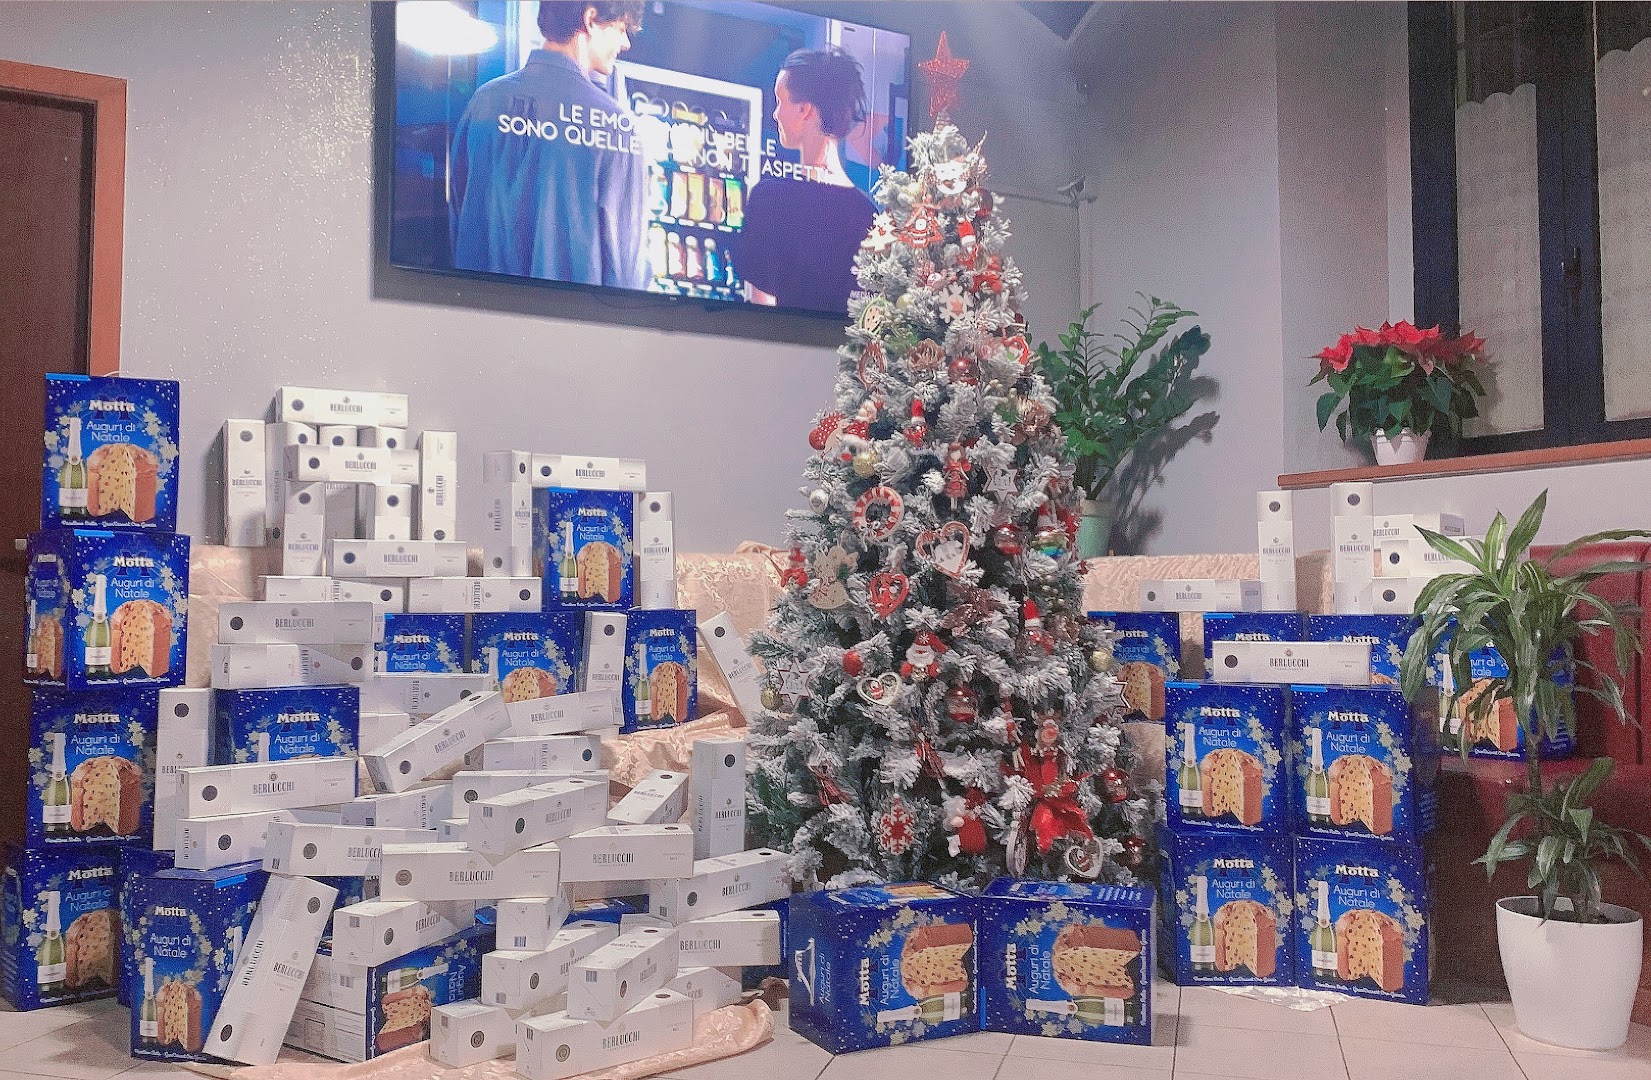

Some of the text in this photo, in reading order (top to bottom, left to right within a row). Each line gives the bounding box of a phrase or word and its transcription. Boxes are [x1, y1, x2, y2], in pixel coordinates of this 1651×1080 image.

[498, 114, 559, 141] SONO
[564, 125, 641, 155] QUELLE
[559, 103, 583, 125] LE
[725, 131, 777, 158] BEE
[89, 400, 136, 412] Motta
[330, 403, 363, 413] BERLUCCHI
[86, 421, 136, 434] Auguri di
[91, 432, 131, 442] Natale
[345, 460, 376, 470] BERLUCCHI
[578, 508, 608, 518] Motta
[576, 524, 609, 534] Auguri di
[579, 533, 605, 541] Natale
[113, 556, 154, 568] Motta
[384, 554, 418, 563] BERLUCCHI
[111, 577, 155, 591] Auguri di
[115, 588, 150, 600] Natale
[275, 619, 315, 629] BERLUCCHI
[503, 632, 539, 641] Motta
[650, 628, 675, 637] Motta
[1235, 633, 1270, 641] Motta
[393, 634, 431, 644] Motta
[1342, 635, 1381, 644] Motta
[391, 651, 431, 662] Auguri di
[502, 649, 540, 660] Auguri di
[395, 661, 427, 670] Natale
[505, 658, 535, 667] Natale
[1270, 657, 1309, 668] BERLUCCHI
[1471, 667, 1492, 677] tale
[73, 713, 120, 724] Motta
[277, 712, 320, 724] Motta
[530, 709, 564, 723] BERLUCCHI
[1200, 707, 1241, 718] Motta
[1328, 711, 1369, 723] Motta
[275, 733, 320, 745] Auguri di
[1199, 727, 1242, 739] Auguri di
[1326, 732, 1370, 743] Auguri di
[71, 735, 121, 746] Auguri di
[434, 730, 467, 754] BERLUCCHI
[1203, 737, 1237, 748] Natale
[76, 745, 115, 755] Natale
[280, 744, 316, 755] Natale
[1330, 742, 1366, 754] Natale
[253, 781, 295, 795] BERLUCCHI
[592, 852, 635, 865] BERLUCCHI
[1213, 858, 1254, 870] Motta
[68, 867, 114, 881] Motta
[449, 870, 494, 882] BERLUCCHI
[1335, 865, 1379, 878] Motta
[1212, 878, 1256, 890] Auguri di
[1216, 889, 1251, 900] Natale
[1333, 884, 1381, 898] Auguri di
[1339, 896, 1376, 909] Natale
[155, 905, 187, 917] Motta
[151, 933, 191, 947] Auguri di
[680, 939, 721, 951] BERLUCCHI
[154, 946, 187, 958] Natale
[1006, 943, 1017, 991] Motta
[1029, 944, 1039, 995] Auguri di
[1040, 950, 1051, 990] Natale
[859, 956, 870, 1007] Motta
[880, 954, 890, 1006] Auguri di
[890, 958, 900, 999] Natale
[449, 971, 457, 1000] Nata
[602, 1030, 640, 1049] BERLUCCHI
